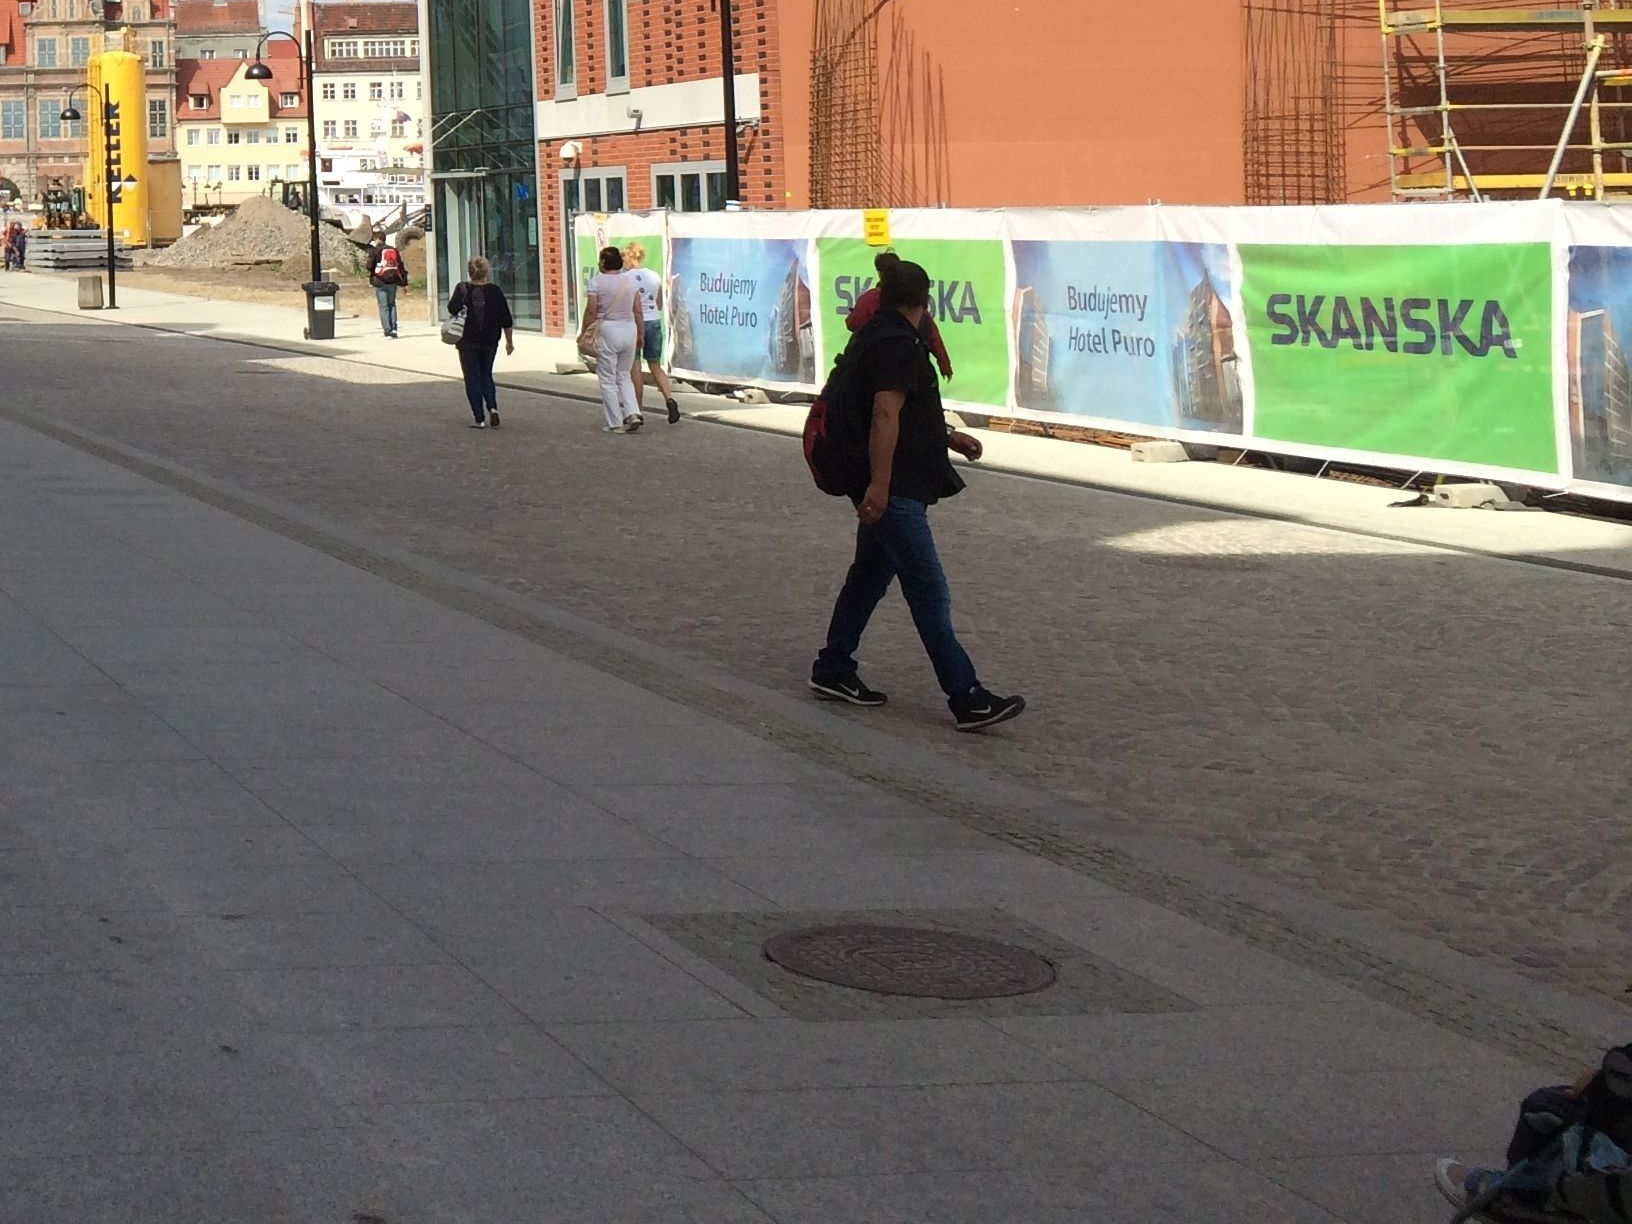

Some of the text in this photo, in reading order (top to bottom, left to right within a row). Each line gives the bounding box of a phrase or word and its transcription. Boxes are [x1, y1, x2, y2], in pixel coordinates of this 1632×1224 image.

[105, 102, 122, 203] KELLER
[699, 272, 757, 301] Budujemy
[1067, 284, 1148, 322] Budujemy
[699, 303, 758, 328] Hotel Puro
[1266, 293, 1518, 359] SKANSKA
[1068, 325, 1156, 358] Hotel Puro
